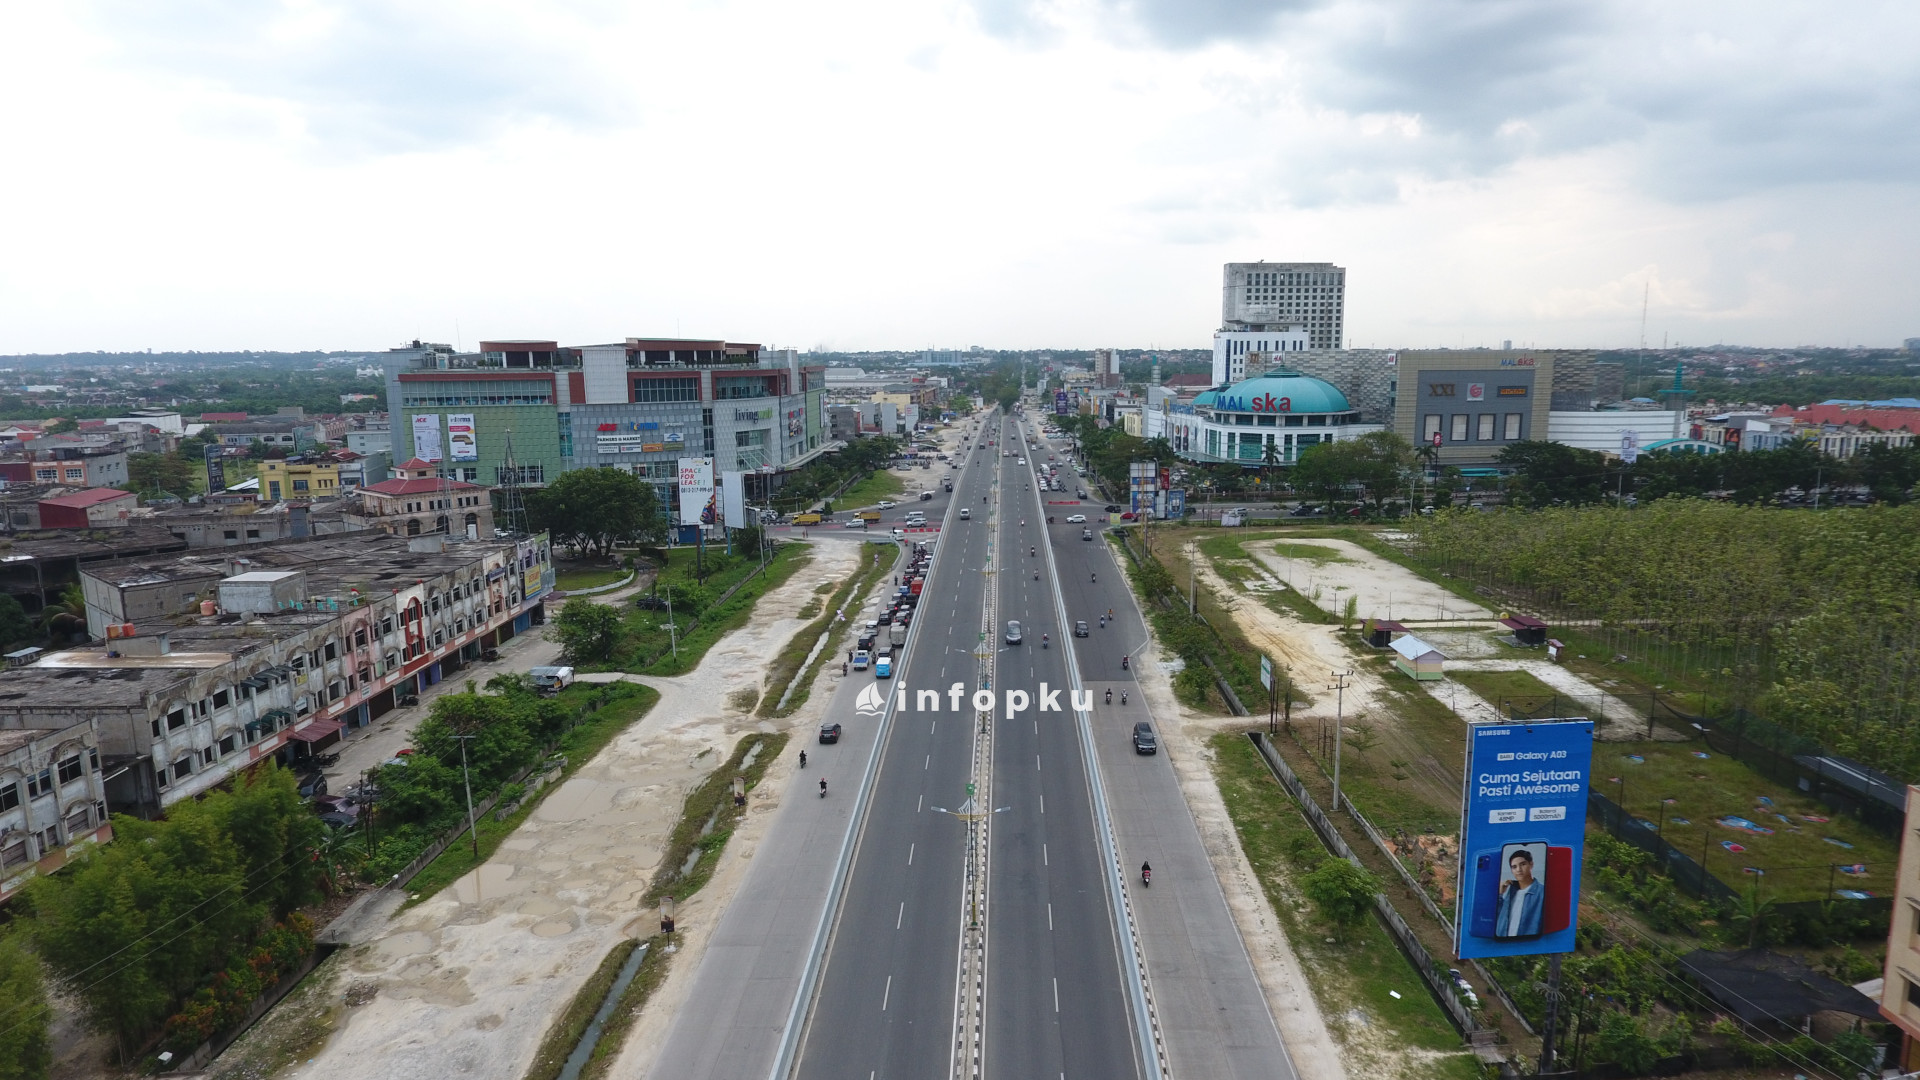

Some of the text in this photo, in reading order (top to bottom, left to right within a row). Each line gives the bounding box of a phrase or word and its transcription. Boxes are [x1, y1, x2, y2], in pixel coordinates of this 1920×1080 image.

[1500, 358, 1516, 366] MAL
[1428, 383, 1456, 396] XXI
[1216, 392, 1291, 412] MAL ska
[597, 423, 617, 431] ACE
[1515, 752, 1549, 762] Galaxy
[1549, 750, 1567, 759] A03
[1479, 770, 1581, 785] Cuma Sejutaan
[1478, 783, 1580, 797] Pasti Awesome
